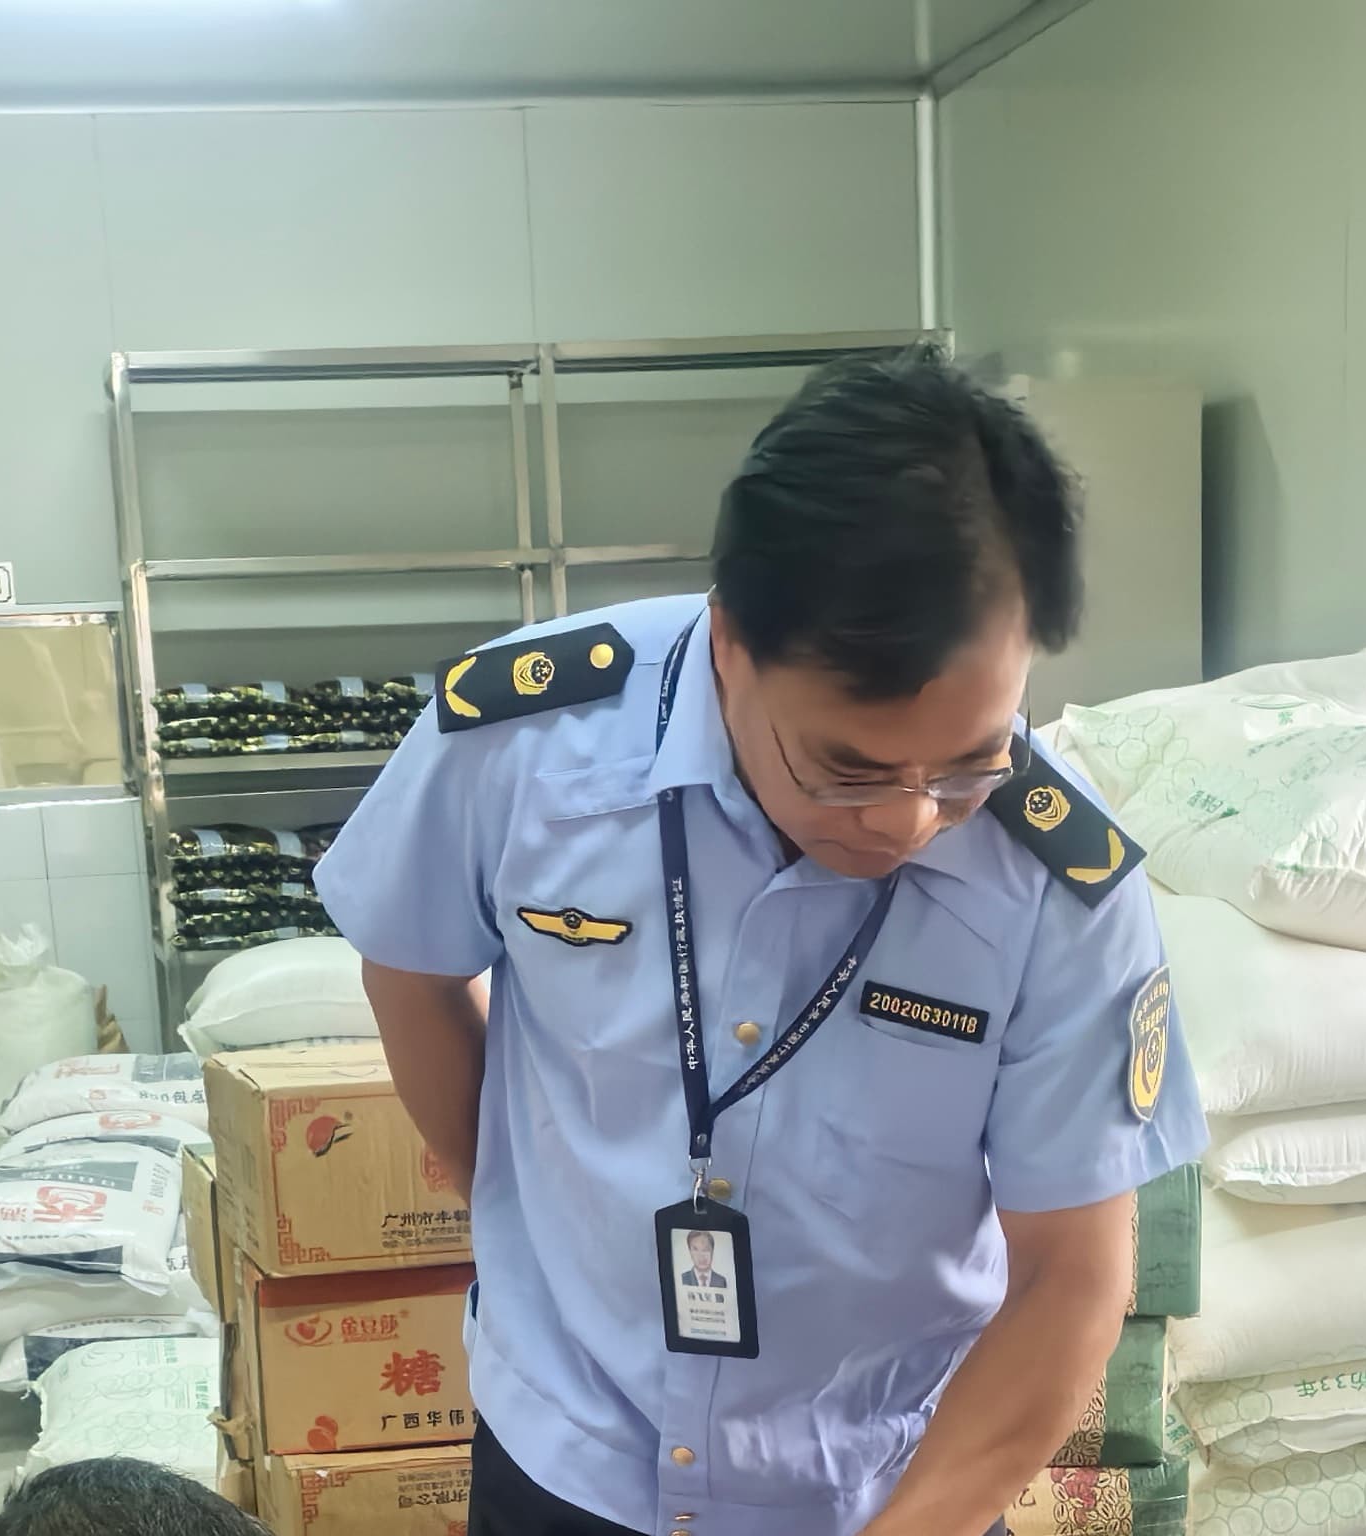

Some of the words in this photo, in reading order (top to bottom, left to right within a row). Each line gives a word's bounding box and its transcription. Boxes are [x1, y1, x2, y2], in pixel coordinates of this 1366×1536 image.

[869, 992, 978, 1035] 20020630118
[379, 1349, 446, 1397] 糖
[381, 1408, 478, 1431] 广西华伟
